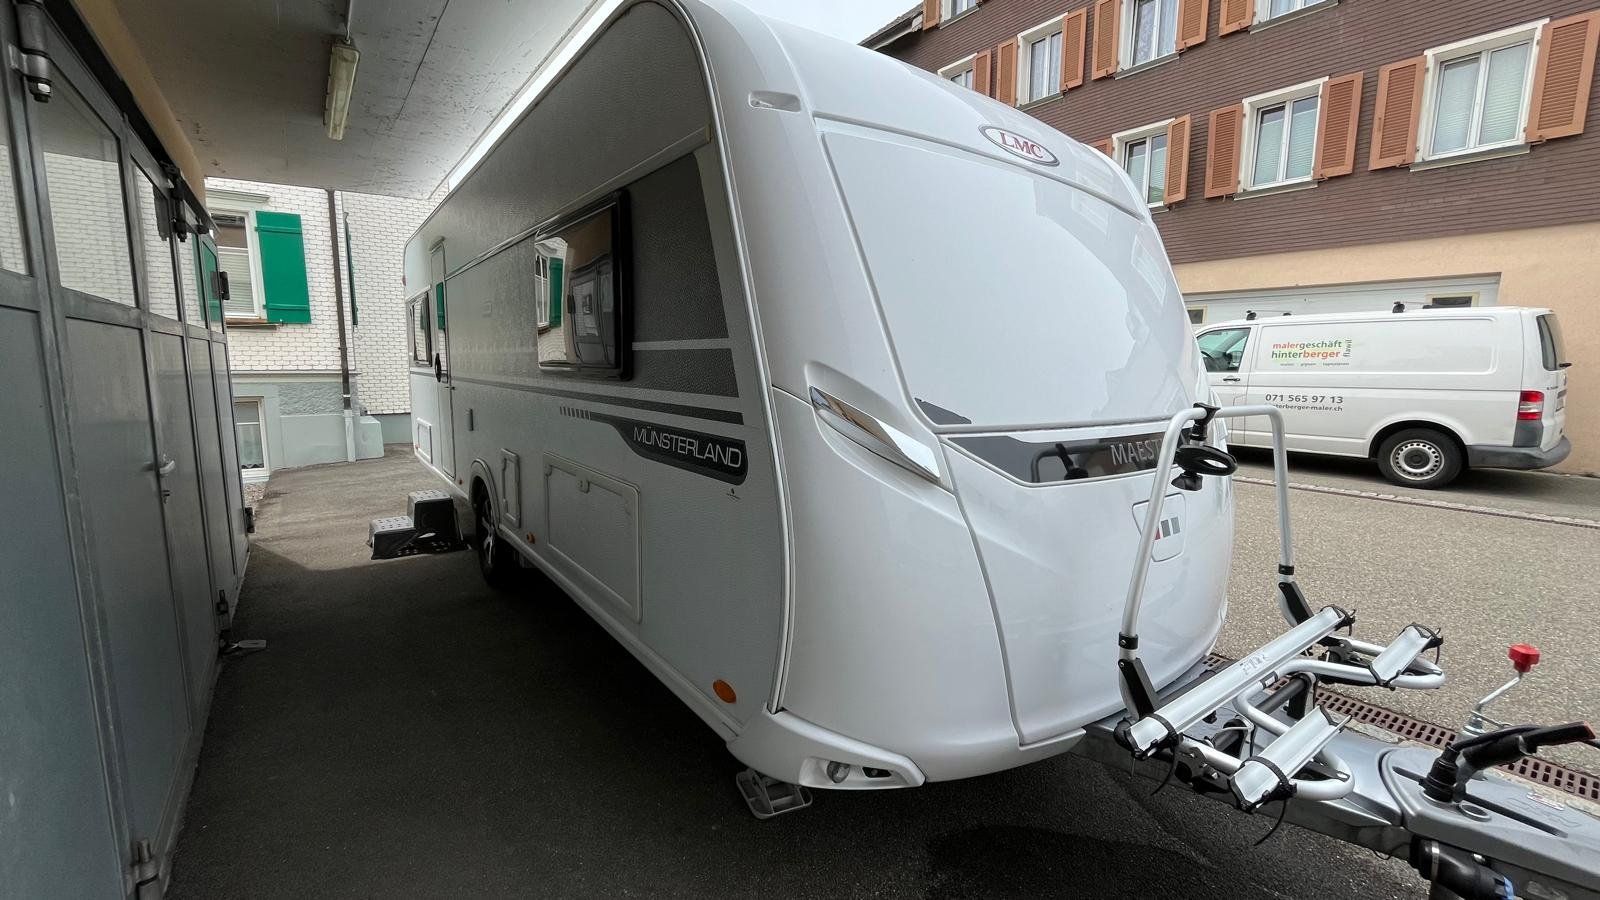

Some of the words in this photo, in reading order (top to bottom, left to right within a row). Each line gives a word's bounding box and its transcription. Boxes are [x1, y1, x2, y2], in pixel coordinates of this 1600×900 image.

[998, 131, 1043, 158] LMC
[1272, 339, 1342, 350] malergeschäft
[1271, 350, 1341, 359] hinterberger
[1265, 393, 1284, 402] 071
[1288, 394, 1308, 403] 565
[1311, 395, 1326, 403] 97
[1330, 396, 1344, 404] 13
[633, 426, 742, 468] MÜNSTERLAND
